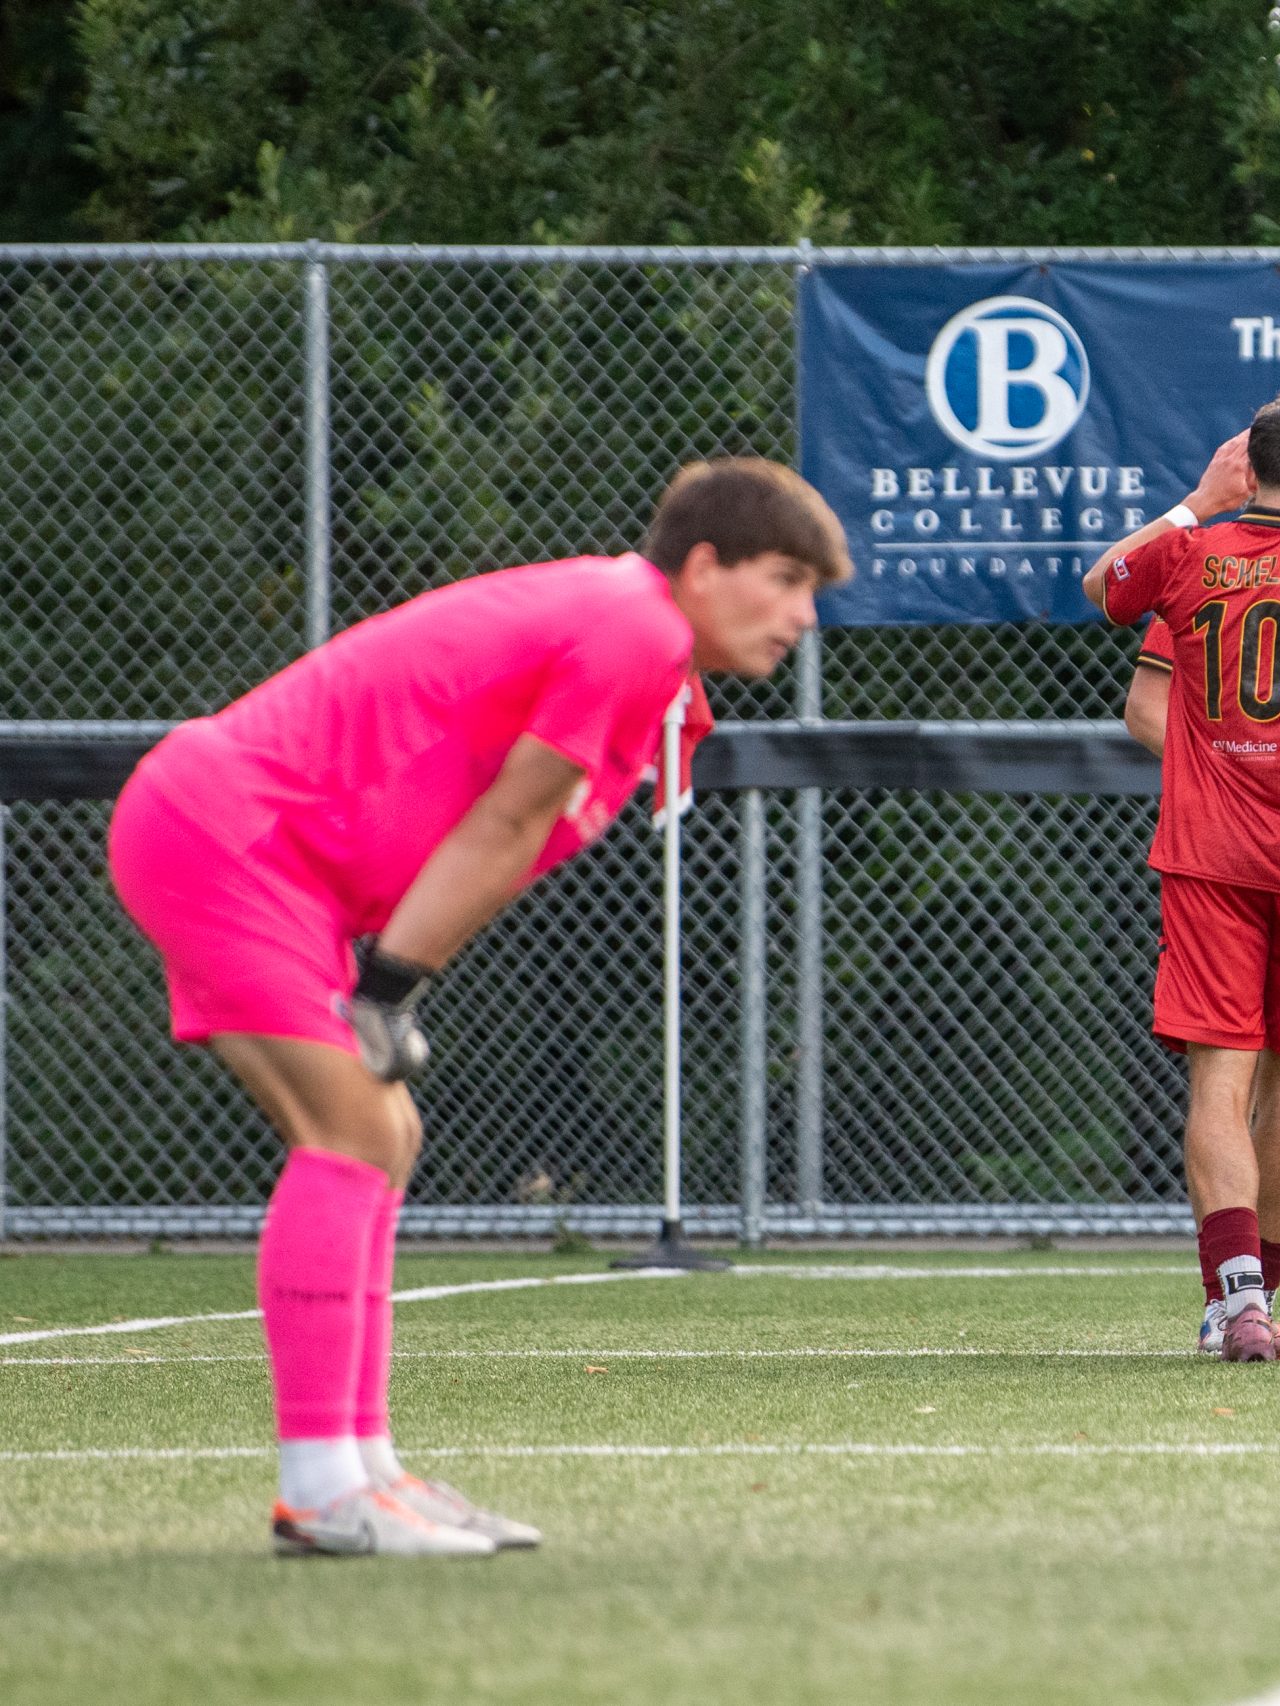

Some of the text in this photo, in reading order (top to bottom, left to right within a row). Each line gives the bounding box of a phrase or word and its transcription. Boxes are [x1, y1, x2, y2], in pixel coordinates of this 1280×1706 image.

[872, 467, 1145, 498] BELLEVUE
[871, 507, 1146, 534] COLLEGE
[872, 556, 1083, 577] FOUNDATI
[1226, 740, 1278, 753] Medicine
